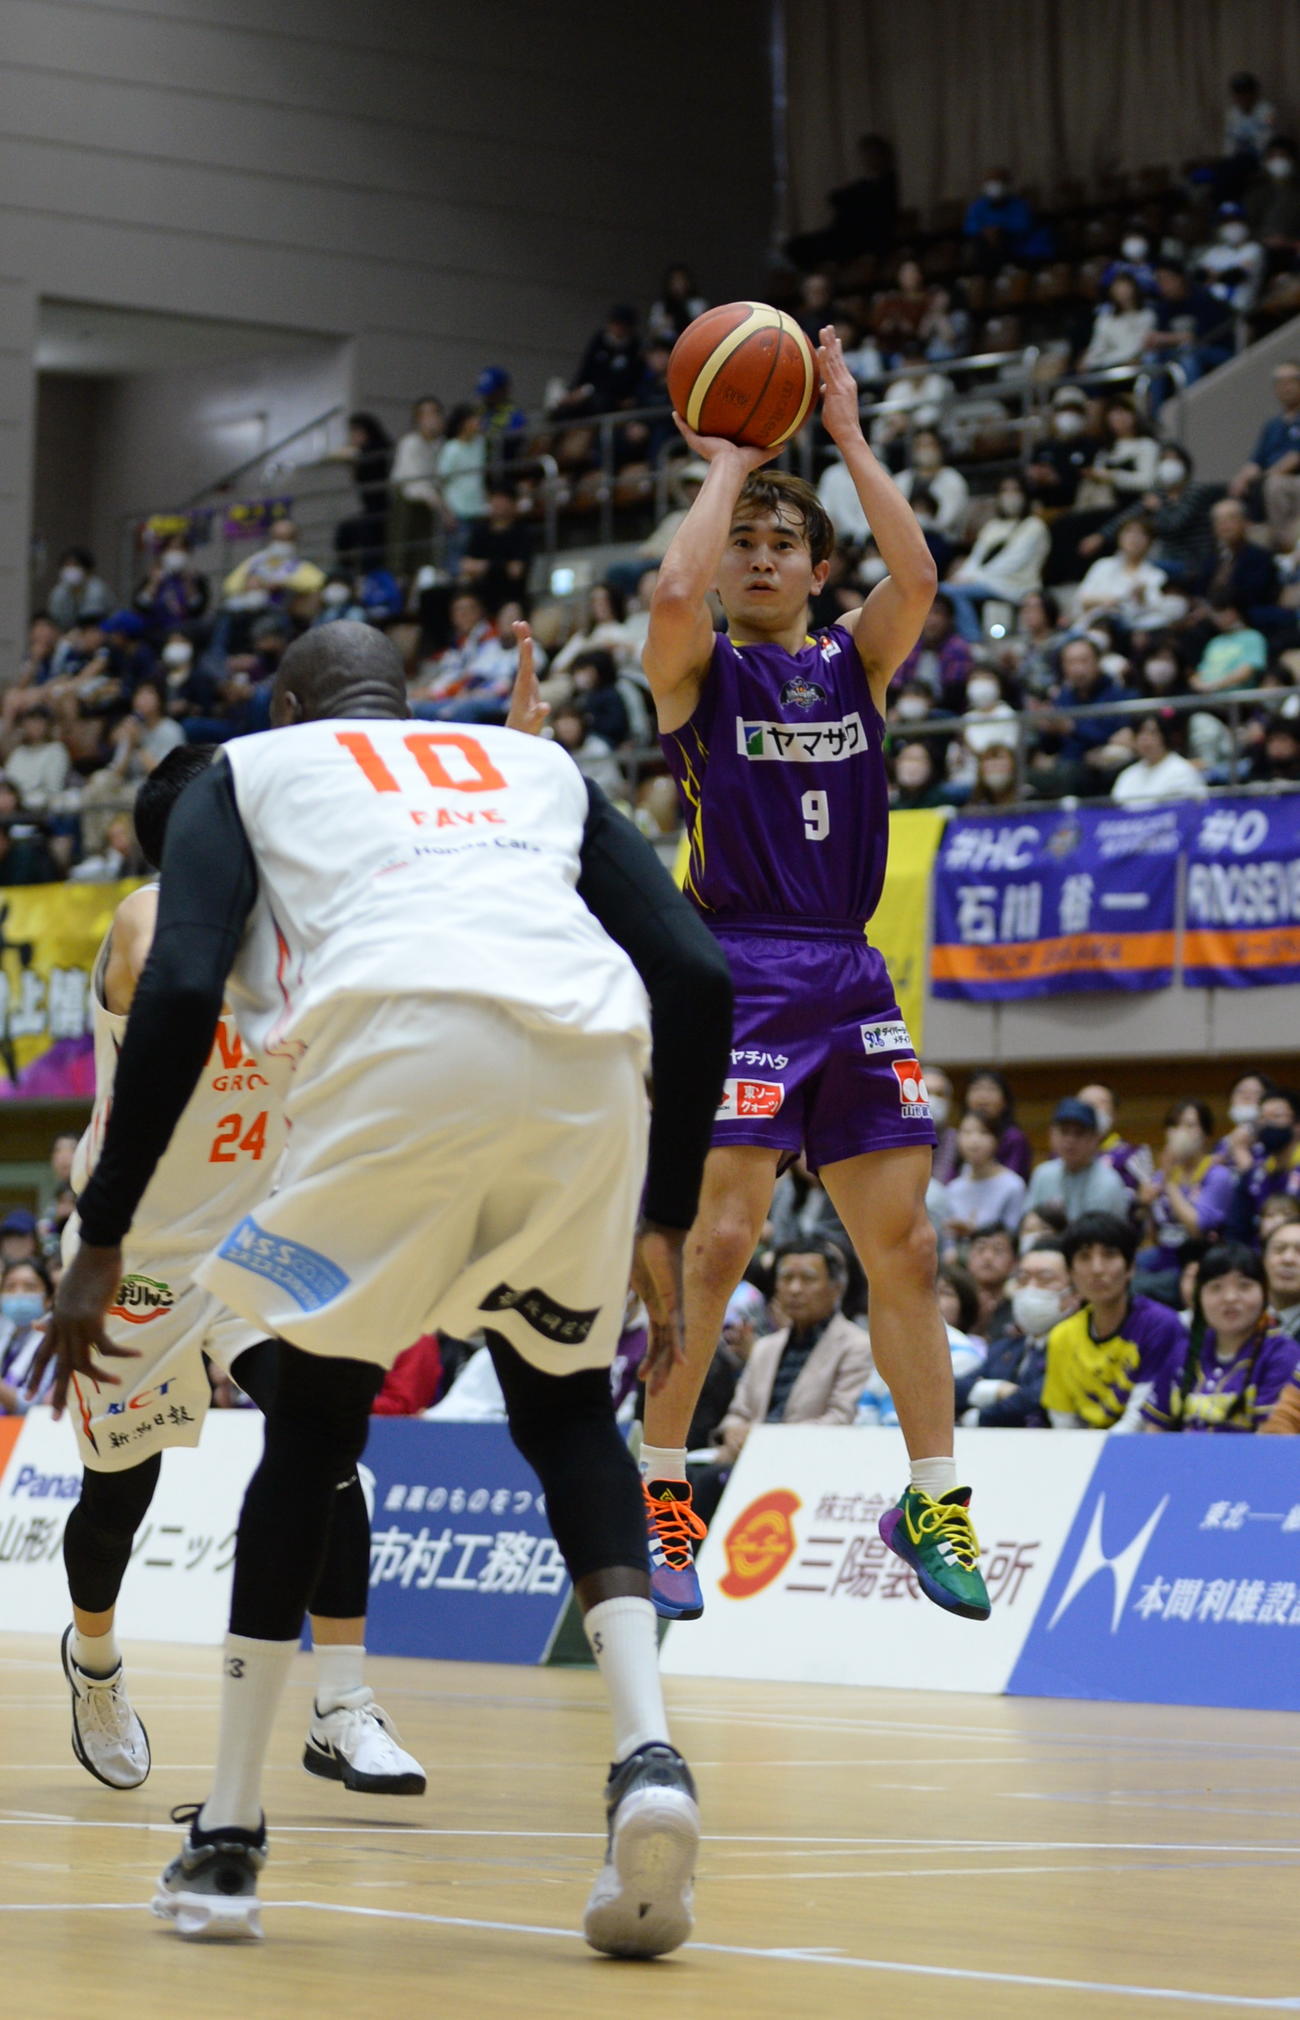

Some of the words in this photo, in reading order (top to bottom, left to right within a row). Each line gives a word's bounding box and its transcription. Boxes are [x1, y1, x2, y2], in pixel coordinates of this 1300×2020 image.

[766, 722, 859, 756] ヤマサワ
[334, 732, 509, 793] 10
[801, 790, 830, 841] 9
[945, 824, 1040, 872] #HC
[730, 1049, 789, 1070] ヤチハタ
[212, 1073, 270, 1092] GRO
[743, 1085, 776, 1099] 東ソー
[208, 1111, 268, 1162] 24
[11, 1464, 83, 1498] Pana
[815, 1492, 898, 1523] 株式会
[369, 1525, 567, 1596] 市村工務店
